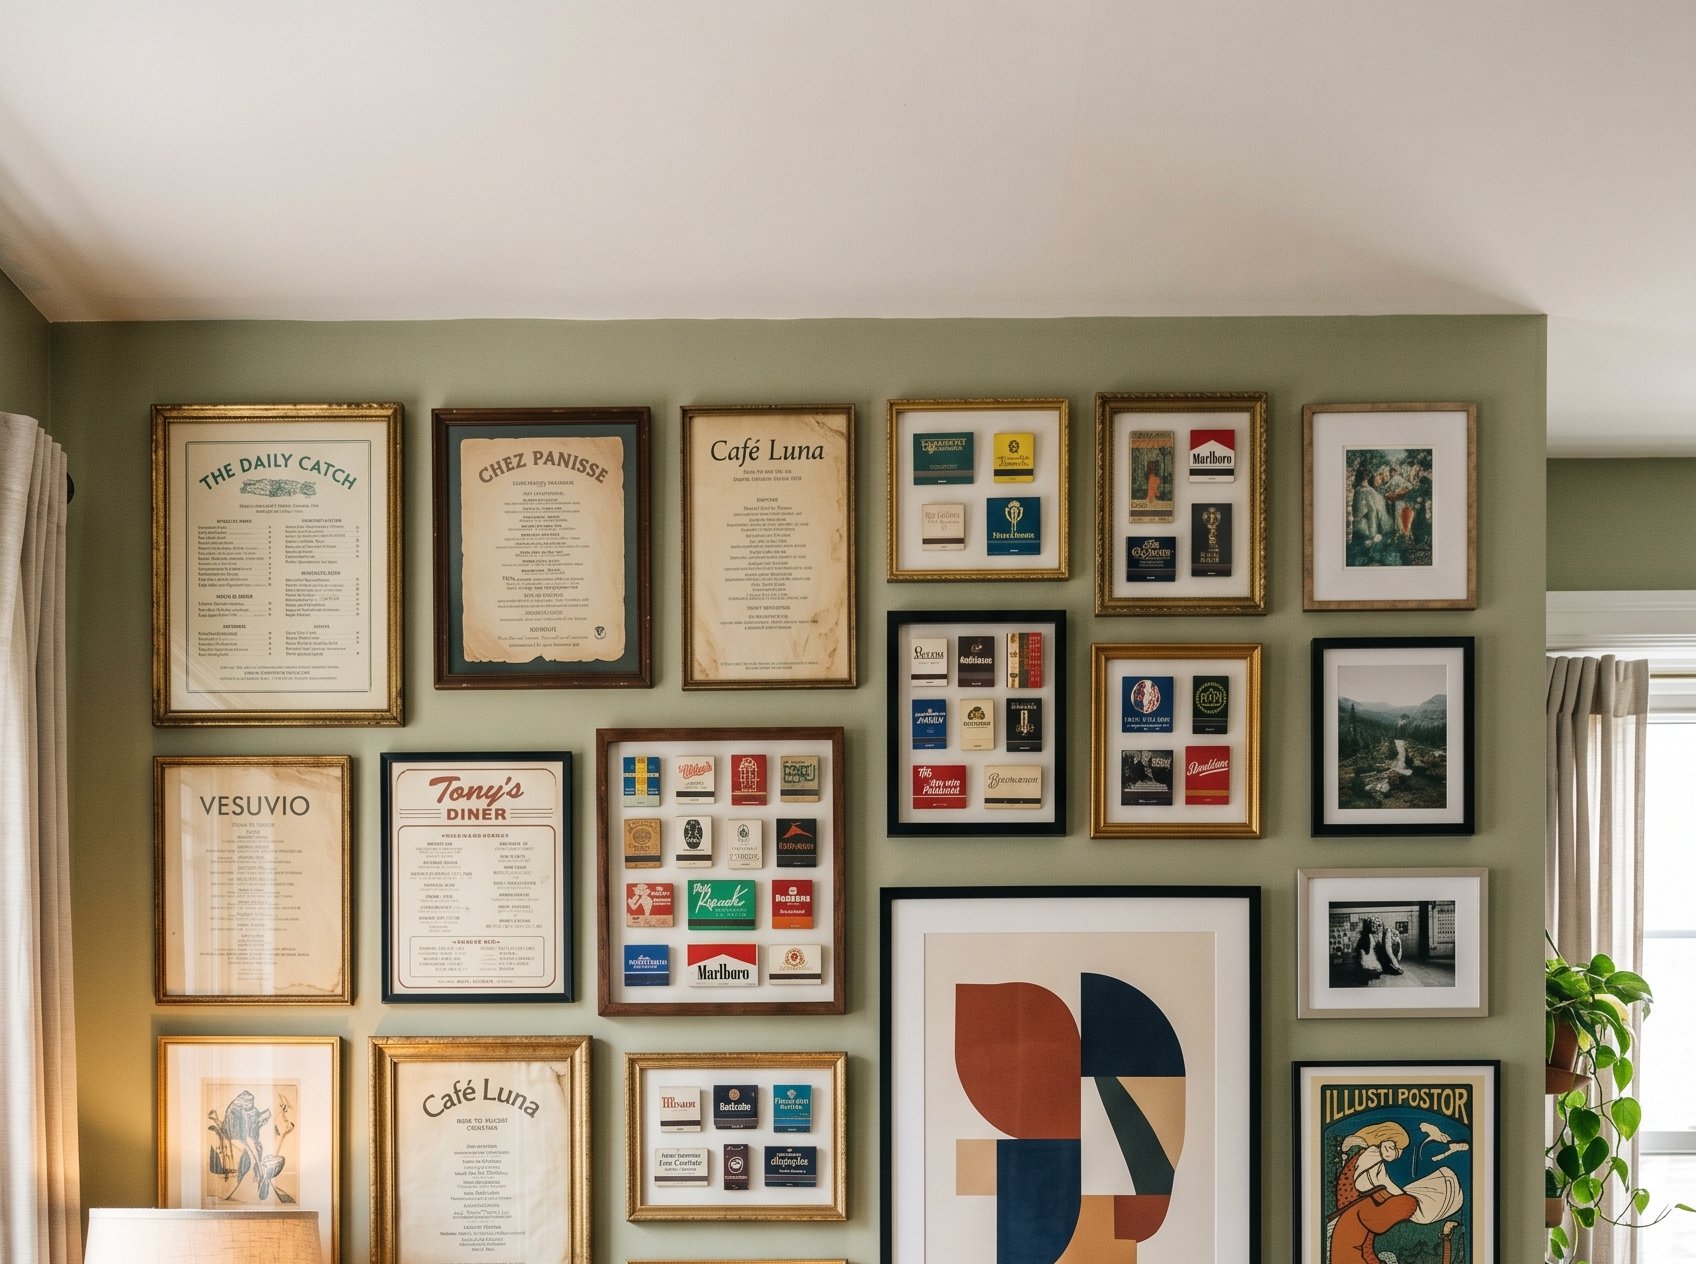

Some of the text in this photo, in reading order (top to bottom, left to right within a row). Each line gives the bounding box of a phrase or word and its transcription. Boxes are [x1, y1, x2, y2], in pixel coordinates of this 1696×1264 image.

[478, 450, 609, 484] CHEZ PANISSE
[710, 437, 825, 467] Café Luna
[1192, 451, 1232, 465] Marlboro
[199, 453, 358, 491] THE DAILY CATCH
[200, 796, 310, 816] VESUVIO
[429, 776, 524, 807] Tony's
[446, 808, 507, 821] DINER
[422, 1078, 540, 1118] Café Luna
[1325, 1088, 1469, 1124] ILLUSTI POSTOR
